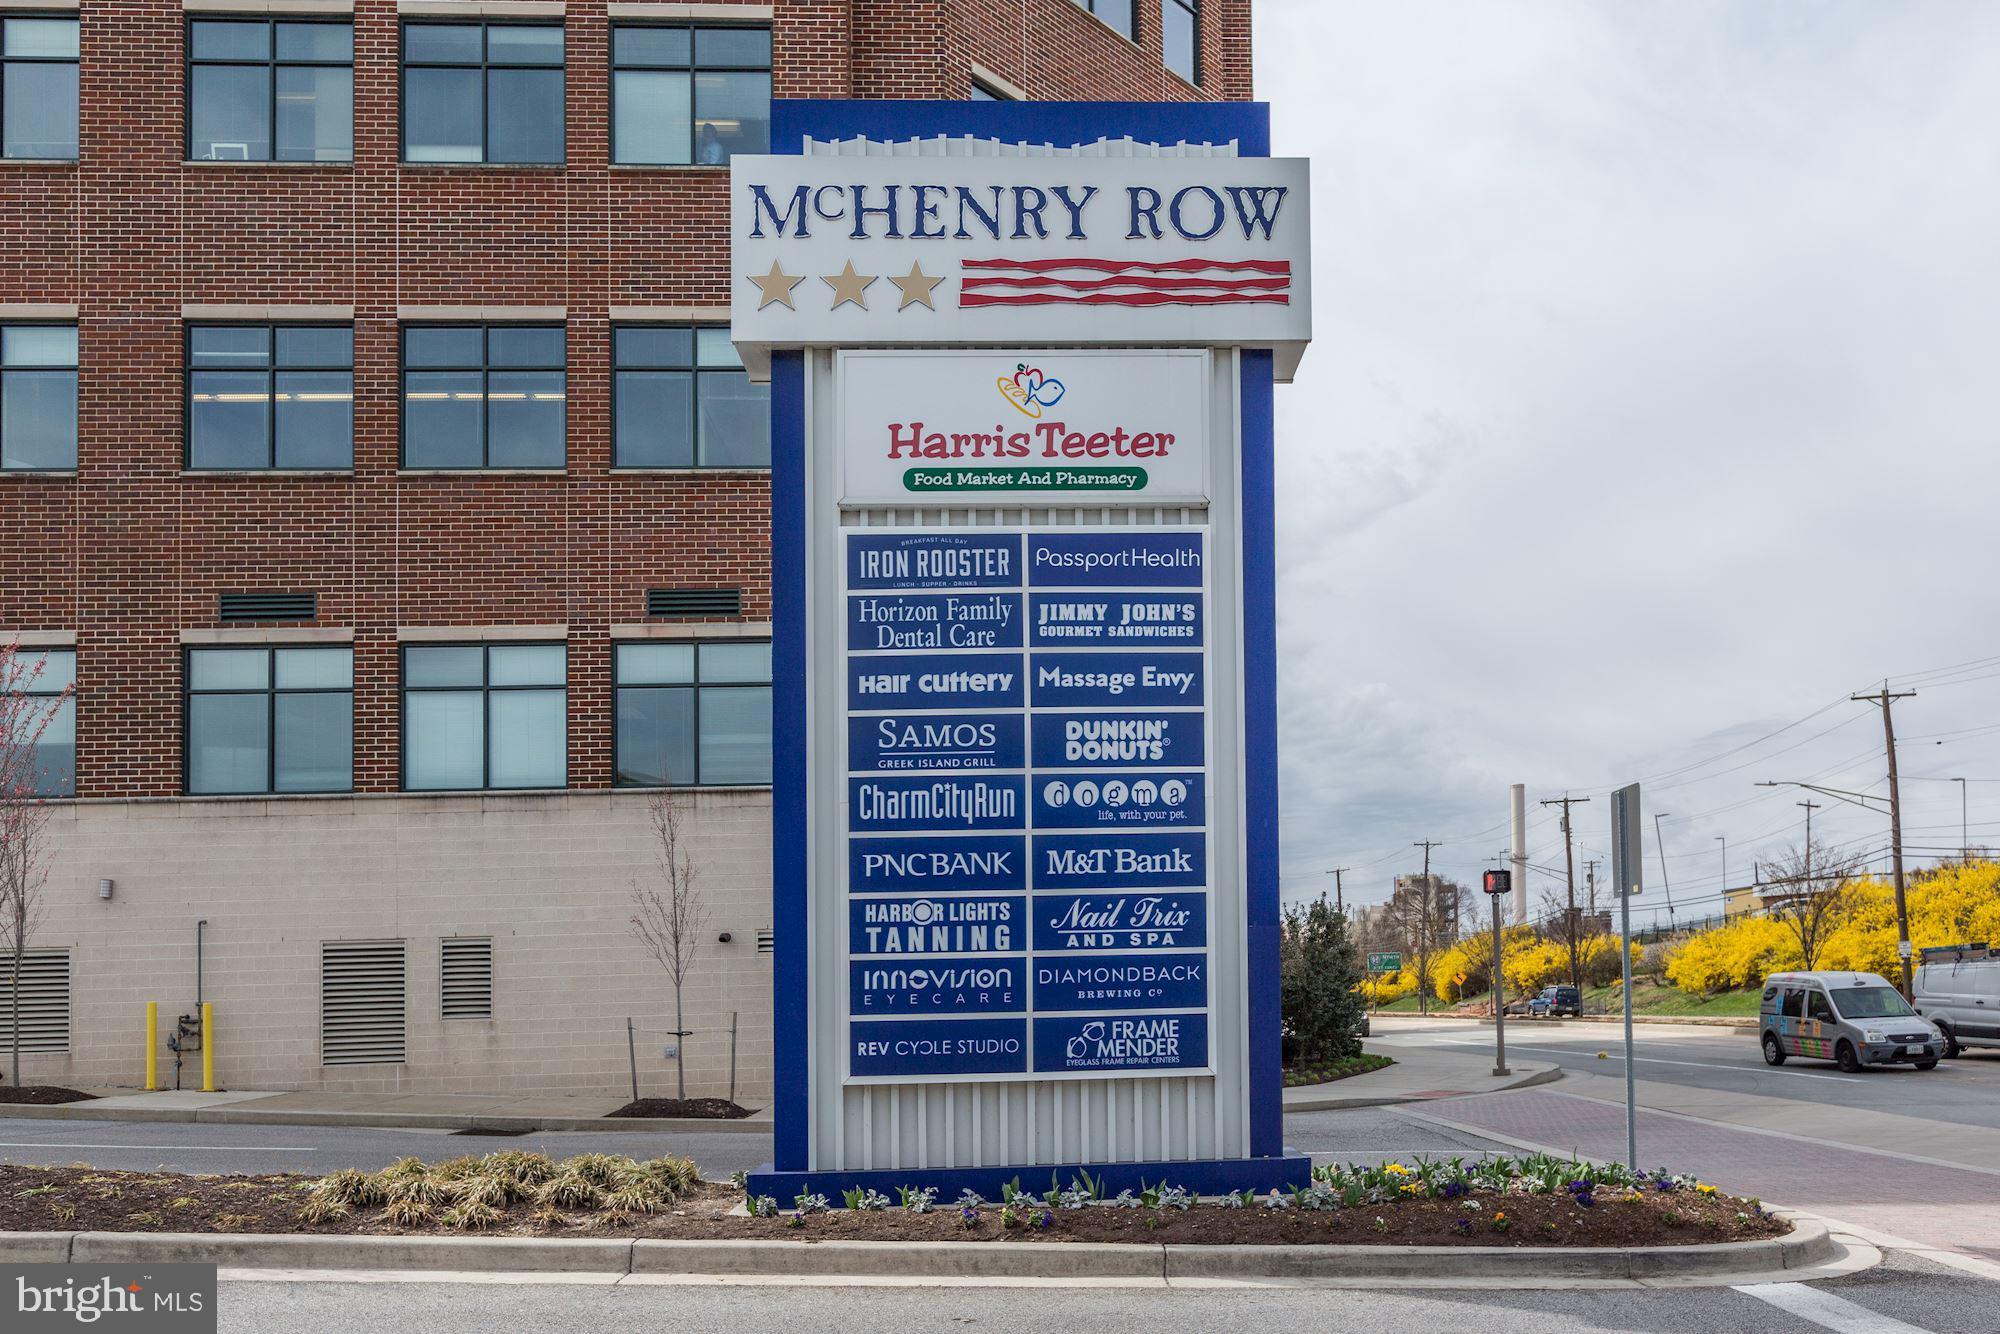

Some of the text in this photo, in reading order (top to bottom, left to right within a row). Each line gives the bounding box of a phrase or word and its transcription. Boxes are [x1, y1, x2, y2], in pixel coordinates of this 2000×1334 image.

[1125, 185, 1289, 240] ROW
[887, 421, 1175, 459] Harris Teeter
[913, 471, 1137, 488] Food Market And Pharmacy
[900, 537, 939, 546] BREAKFAST
[955, 538, 968, 546] DAY
[860, 548, 1010, 578] IRON ROOSTER
[859, 596, 1013, 628] Horizon Family
[1038, 603, 1196, 625] JIMMY JOHN'S
[877, 623, 996, 649] Dental Care
[1039, 625, 1195, 638] GOURMET SANDWICHES
[1039, 665, 1195, 695] Massage Envy
[878, 718, 997, 749] SAMOS
[1065, 740, 1164, 761] DONUTS
[878, 757, 996, 768] GREEK ISLAND GRILL
[1052, 782, 1183, 807] dogma
[1098, 809, 1116, 821] life,
[1119, 809, 1141, 820] with
[1143, 811, 1167, 822] your
[1047, 848, 1193, 875] M&T Bank
[866, 899, 1011, 925] HARBOR LIGHTS
[1050, 896, 1191, 930] Nail Trix
[866, 924, 1011, 953] TANNING
[1066, 933, 1175, 948] AND SPA
[1039, 965, 1200, 985] DIAMONDBACK
[1077, 989, 1142, 999] BREWING
[1112, 1019, 1180, 1040] FRAME
[857, 1038, 1020, 1056] REV CYCLE STUDIO
[1096, 1037, 1180, 1058] MENDER
[1066, 1056, 1180, 1067] EYEGLASS FRAME REPAIR CENTERS
